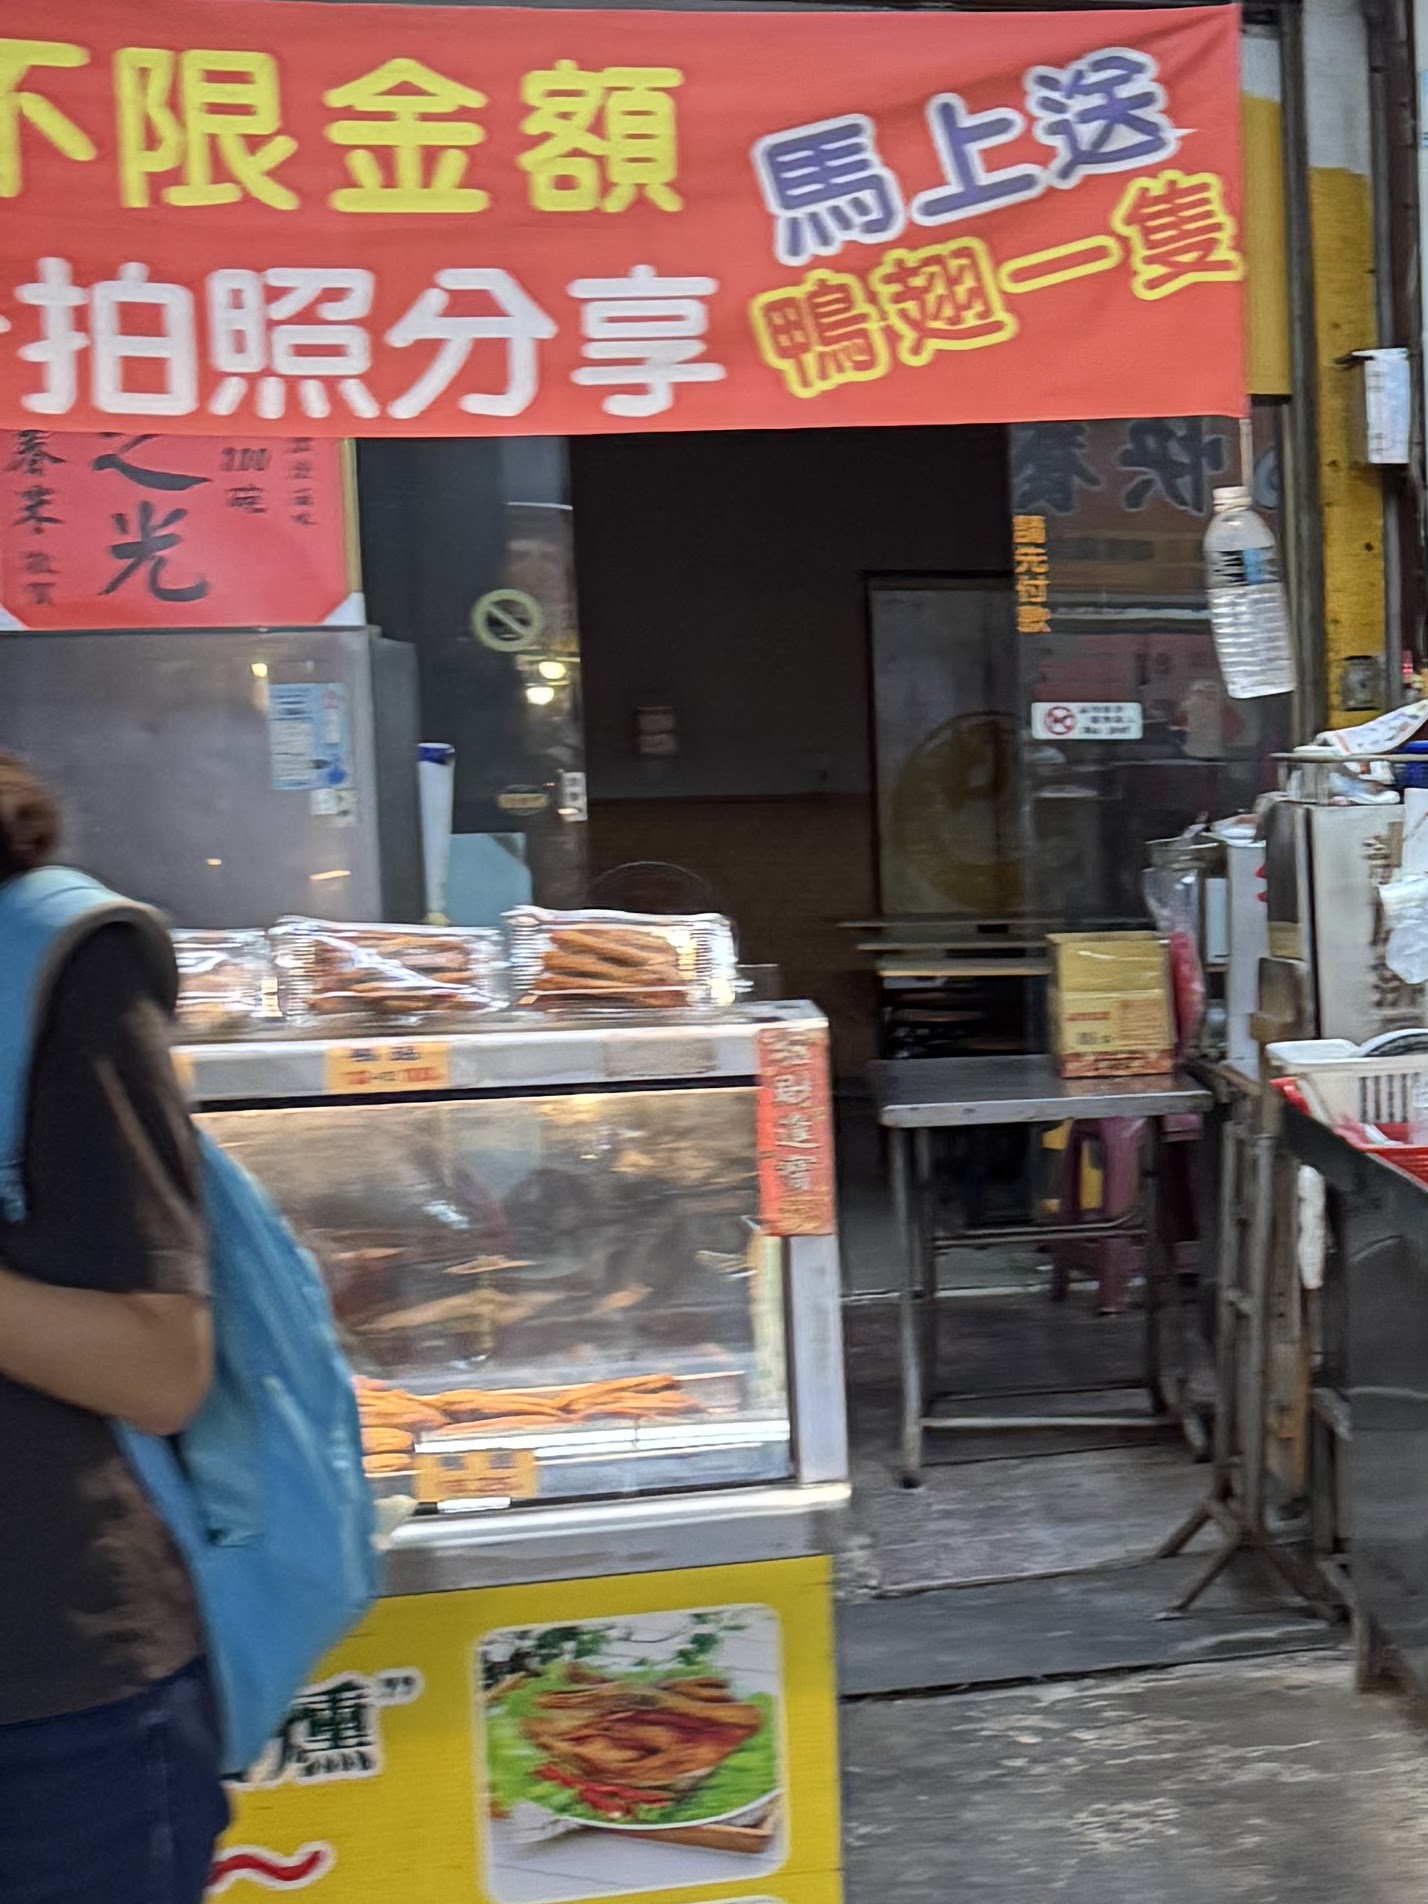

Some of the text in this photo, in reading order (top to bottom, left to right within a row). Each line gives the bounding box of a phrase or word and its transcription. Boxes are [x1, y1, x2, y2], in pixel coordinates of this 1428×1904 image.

[752, 46, 1182, 266] 馬上送
[14, 256, 728, 417] 拍照分享
[750, 169, 1245, 399] 鴨翅一隻
